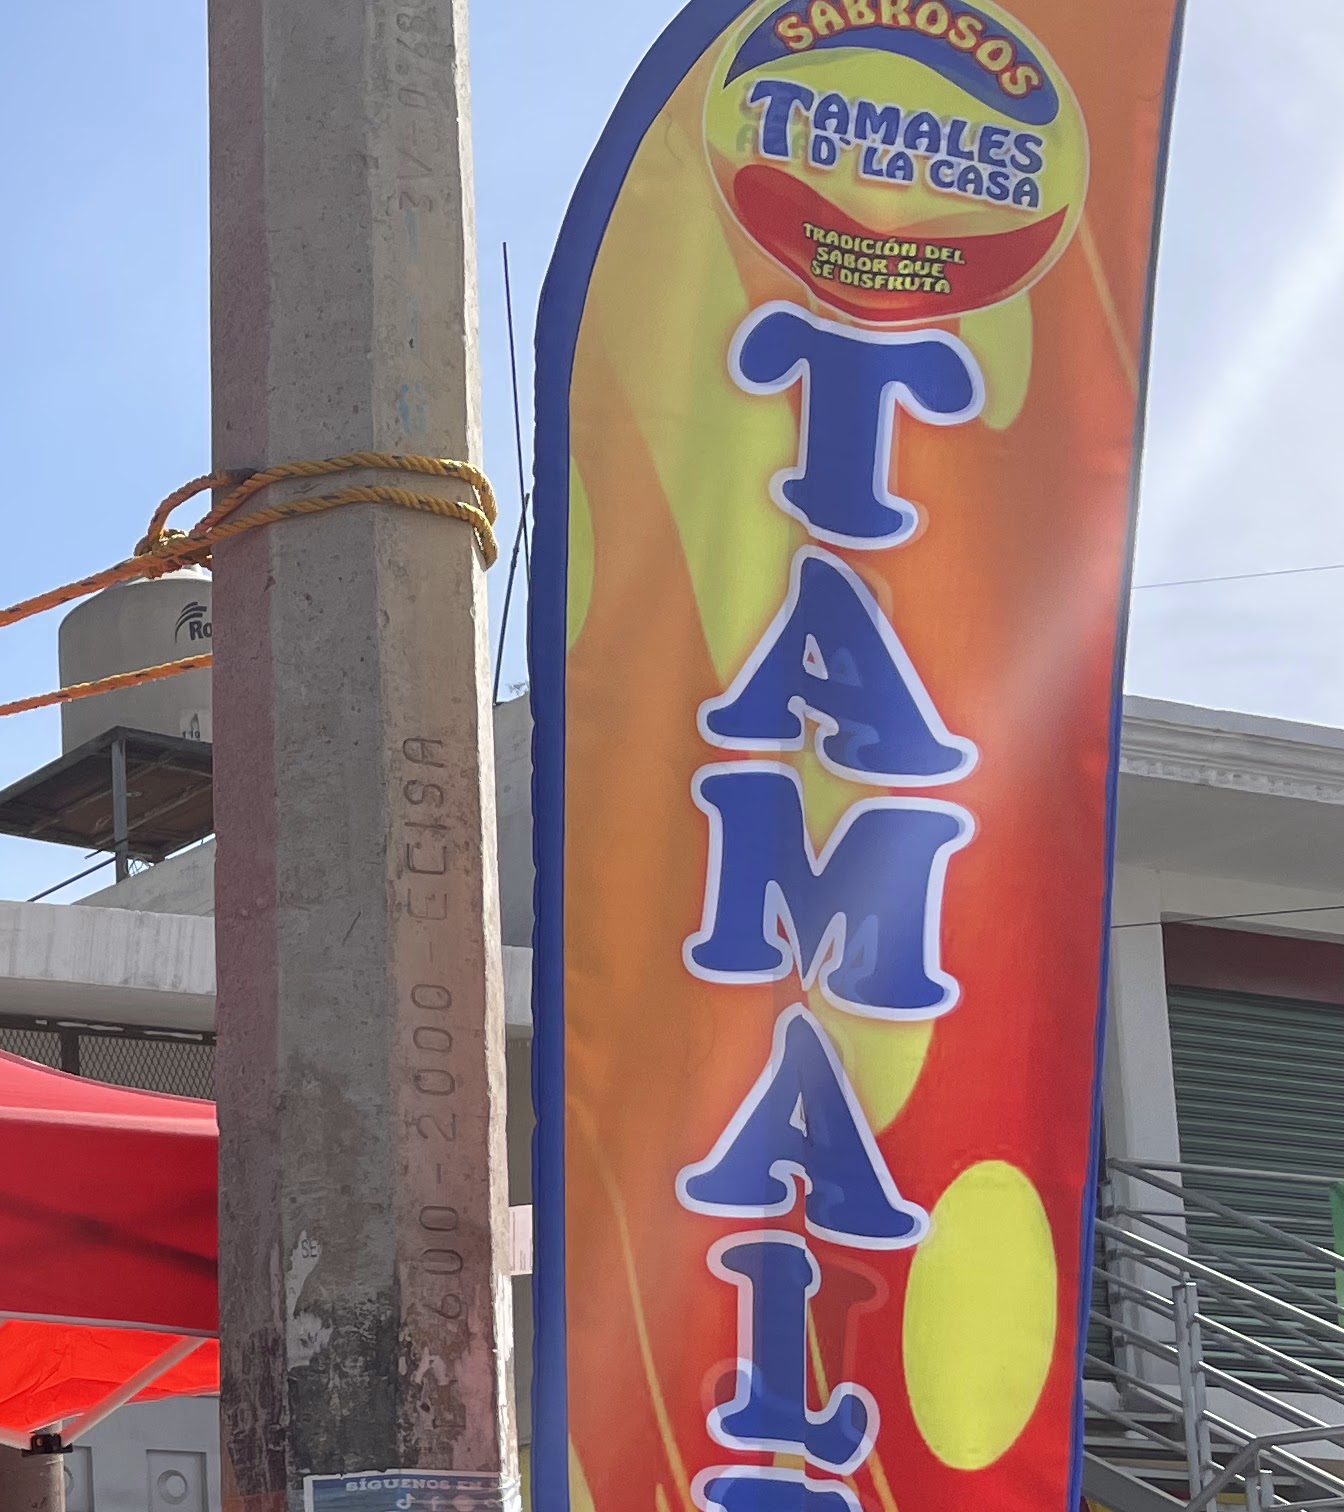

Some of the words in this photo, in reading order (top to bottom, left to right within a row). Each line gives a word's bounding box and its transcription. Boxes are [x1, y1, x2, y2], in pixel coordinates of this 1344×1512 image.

[776, 0, 1043, 98] SABROSOS
[749, 79, 1044, 175] TAMALES
[929, 158, 1040, 208] CASA
[803, 222, 916, 257] TRADICIÓN
[925, 245, 965, 264] DEL
[816, 246, 887, 273] SABOR
[898, 259, 944, 277] QUE
[811, 260, 834, 278] SE
[840, 268, 951, 294] DISFRUTA
